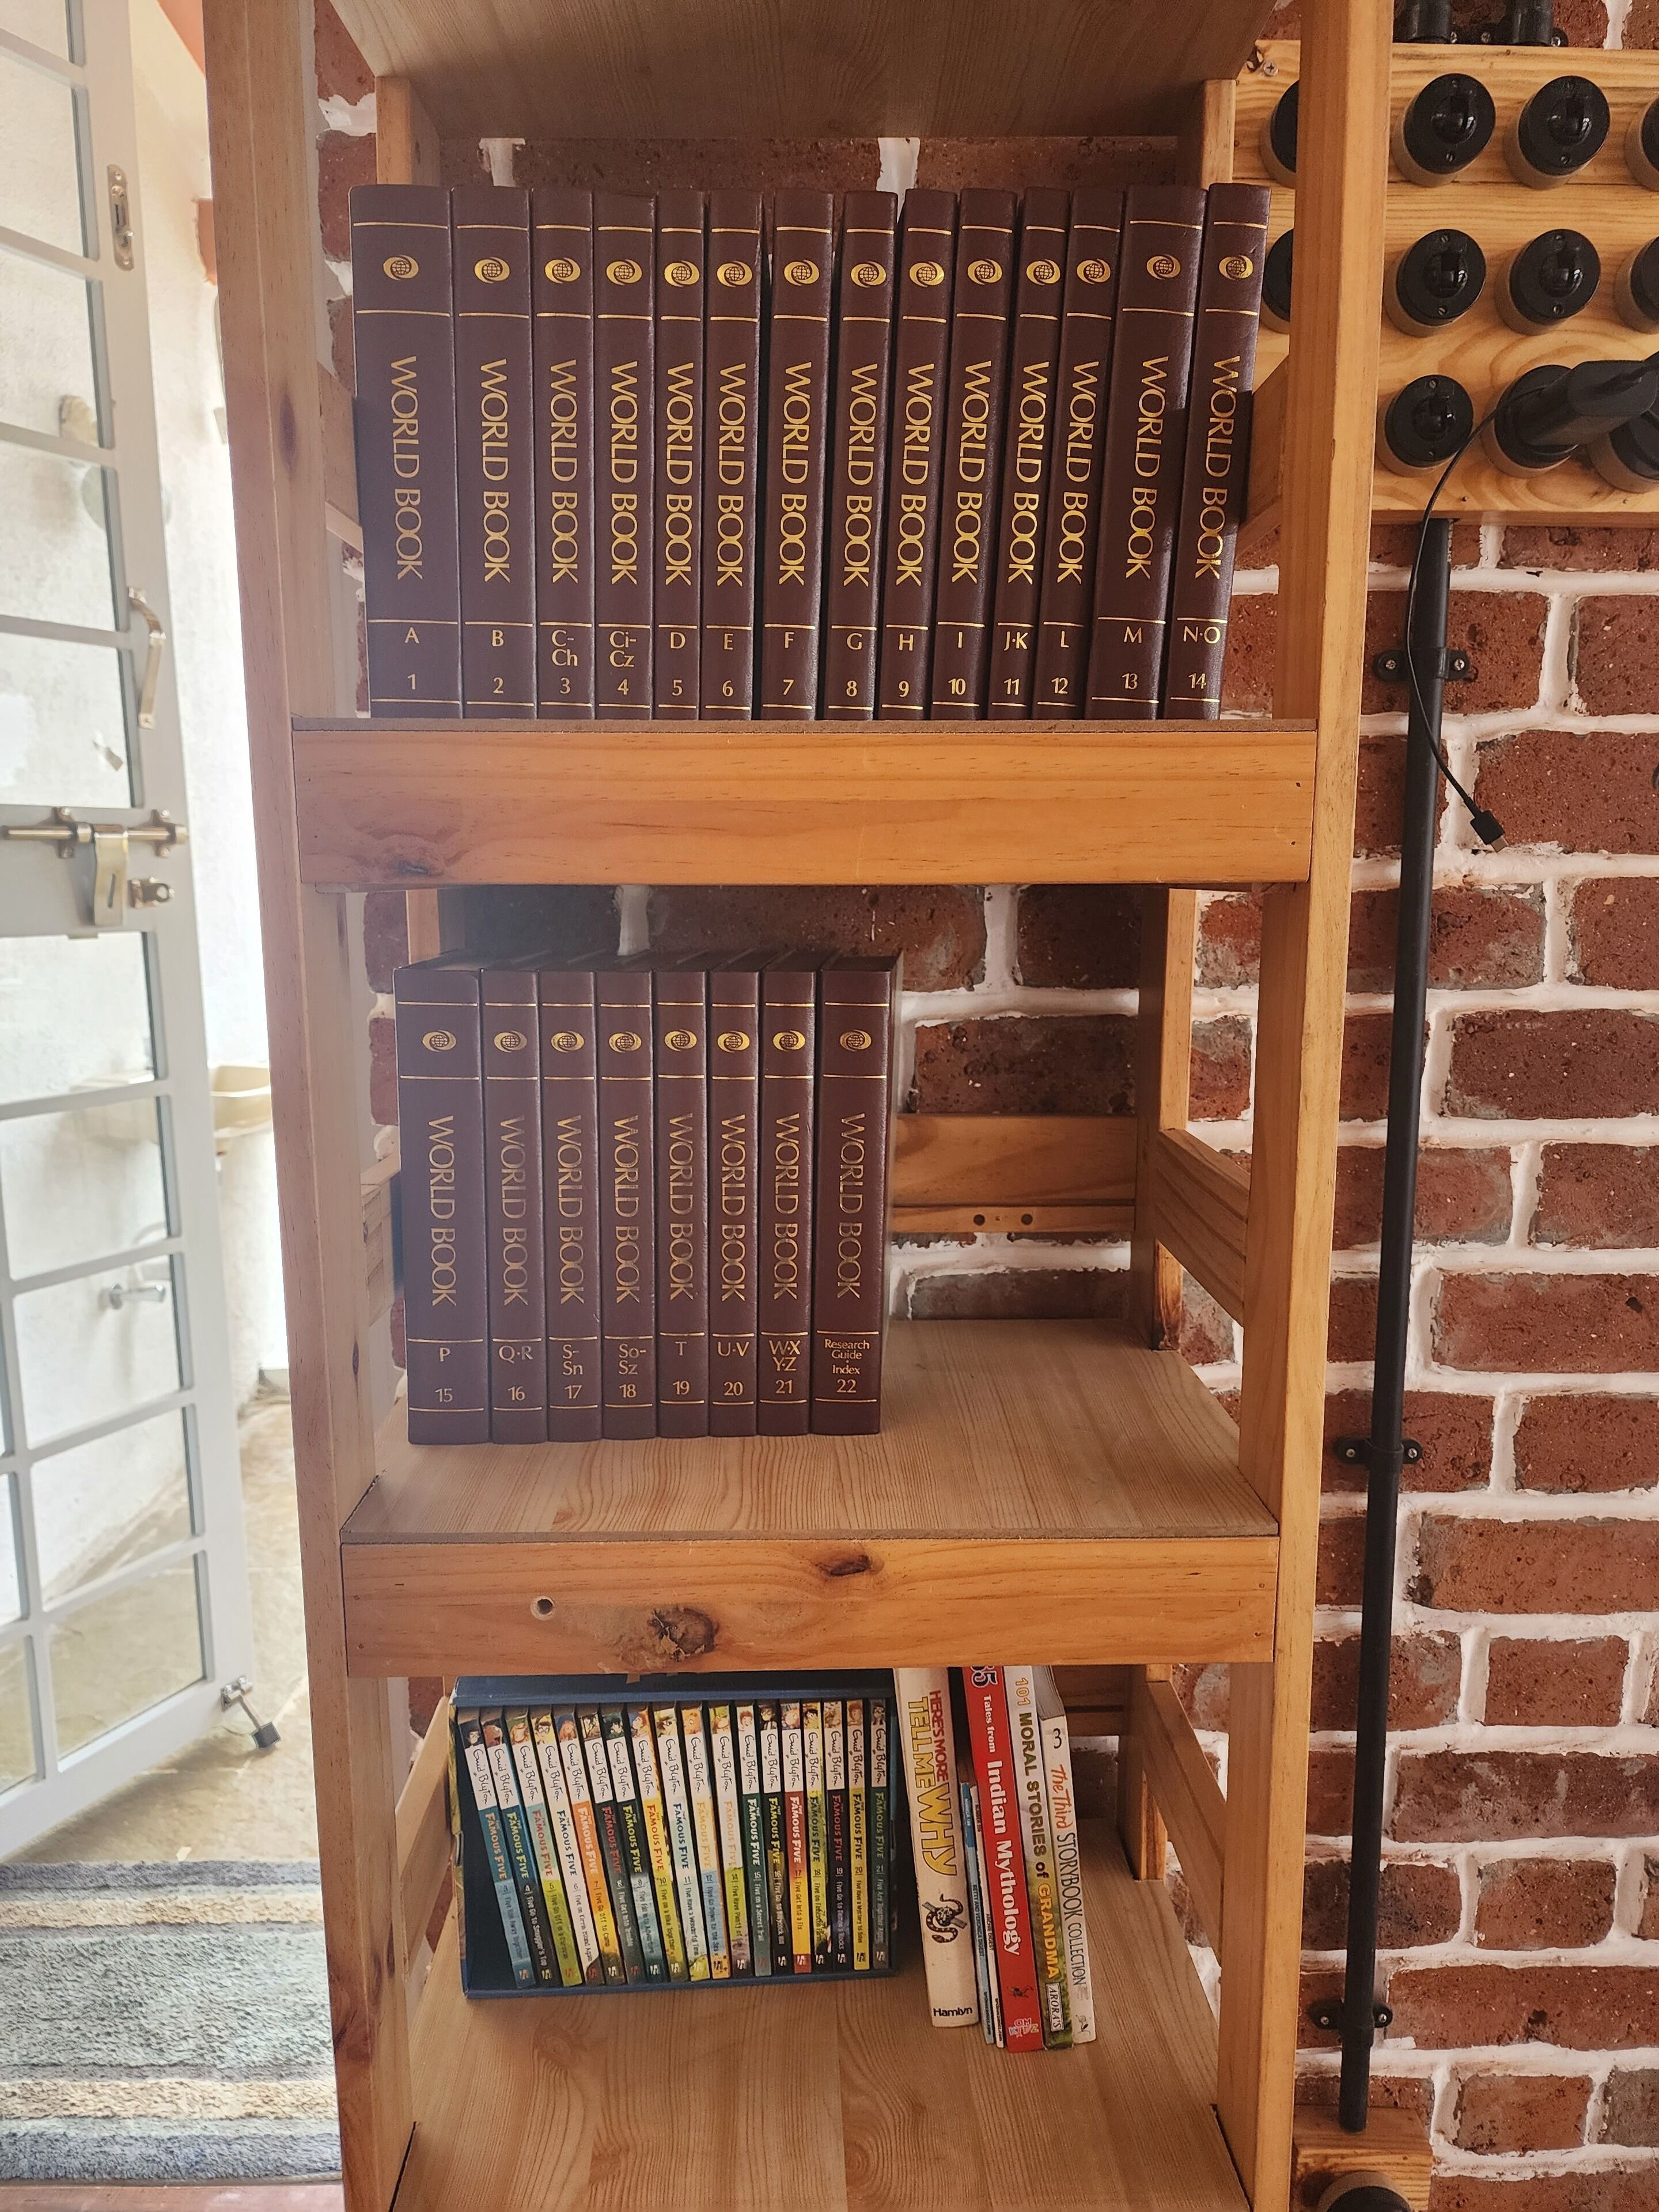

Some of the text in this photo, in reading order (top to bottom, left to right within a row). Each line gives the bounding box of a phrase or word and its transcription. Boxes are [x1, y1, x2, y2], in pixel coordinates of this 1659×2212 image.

[391, 356, 422, 579] WORLD BOOK
[481, 359, 510, 582] WORLD BOOK
[551, 360, 578, 583] WORLD BOOK
[611, 361, 637, 584] WORLD BOOK
[666, 363, 693, 585] WORLD BOOK
[717, 363, 746, 586] WORLD BOOK
[779, 362, 811, 585] WORLD BOOK
[844, 364, 877, 586] WORLD BOOK
[896, 364, 934, 586] WORLD BOOK
[952, 361, 991, 584] WORLD BOOK
[1008, 362, 1049, 584] WORLD BOOK
[1058, 362, 1099, 584] WORLD BOOK
[1126, 356, 1168, 579] WORLD BOOK
[1195, 356, 1240, 579] WORLD BOOK
[405, 627, 419, 643] A
[493, 630, 503, 646] B
[552, 630, 574, 646] C-
[610, 631, 636, 647] Ci-
[671, 632, 685, 649] D
[724, 634, 733, 650] E
[785, 632, 794, 648] F
[847, 633, 862, 650] G
[899, 634, 913, 650] H
[959, 632, 962, 647] I
[1060, 631, 1069, 647] L
[1124, 627, 1141, 643] M
[552, 649, 577, 666] Ch
[610, 650, 634, 667] Cz
[408, 674, 415, 690] 1
[493, 677, 503, 693] 2
[560, 678, 570, 694] 3
[618, 679, 628, 695] 4
[672, 680, 682, 695] 5
[723, 681, 733, 696] 6
[783, 680, 794, 695] 7
[847, 681, 857, 696] 8
[899, 681, 908, 697] 9
[949, 679, 965, 695] 10
[1004, 679, 1019, 695] 11
[1052, 677, 1068, 694] 12
[1122, 673, 1137, 689] 13
[1189, 673, 1206, 689] 14
[429, 1116, 456, 1306] WORLD BOOK
[501, 1115, 528, 1305] WORLD BOOK
[558, 1116, 584, 1304] WORLD BOOK
[615, 1115, 639, 1303] WORLD BOOK
[669, 1113, 693, 1300] WORLD BOOK
[722, 1115, 745, 1301] WORLD BOOK
[774, 1113, 799, 1299] WORLD BOOK
[838, 1113, 865, 1298] WORLD BOOK
[563, 1344, 579, 1358] S-
[619, 1344, 646, 1358] So-
[675, 1342, 687, 1355] T
[825, 1339, 869, 1351] Research
[440, 1348, 450, 1361] P
[832, 1350, 862, 1359] Guide
[563, 1361, 582, 1375] Sn
[619, 1360, 638, 1374] Sz
[833, 1365, 859, 1374] Index
[508, 1387, 525, 1400] 16
[565, 1385, 582, 1399] 17
[619, 1384, 636, 1397] 18
[673, 1381, 689, 1394] 19
[724, 1382, 743, 1395] 20
[776, 1380, 791, 1393] 21
[837, 1380, 856, 1392] 22
[435, 1388, 452, 1402] 15
[983, 1694, 996, 1753] Tales from
[1053, 1728, 1062, 1749] 3
[934, 1738, 949, 1782] MORE
[474, 1748, 492, 1805] Enid Blyton
[908, 1696, 957, 1876] TELL ME WHY
[790, 1797, 801, 1863] FAMOUS FIVE
[853, 1793, 862, 1860] FAMOUS FIVE
[1015, 1677, 1060, 1979] 101 MORAL STORIES of GRANDMA
[557, 1810, 577, 1876] FAMOUS FIVE
[987, 1760, 1021, 1956] Indian Mythology
[1051, 1764, 1087, 1986] The Third STORYBOOK COLLECTION
[933, 2007, 973, 2017] Hamlyn
[1049, 1987, 1062, 2028] ARORA'S
